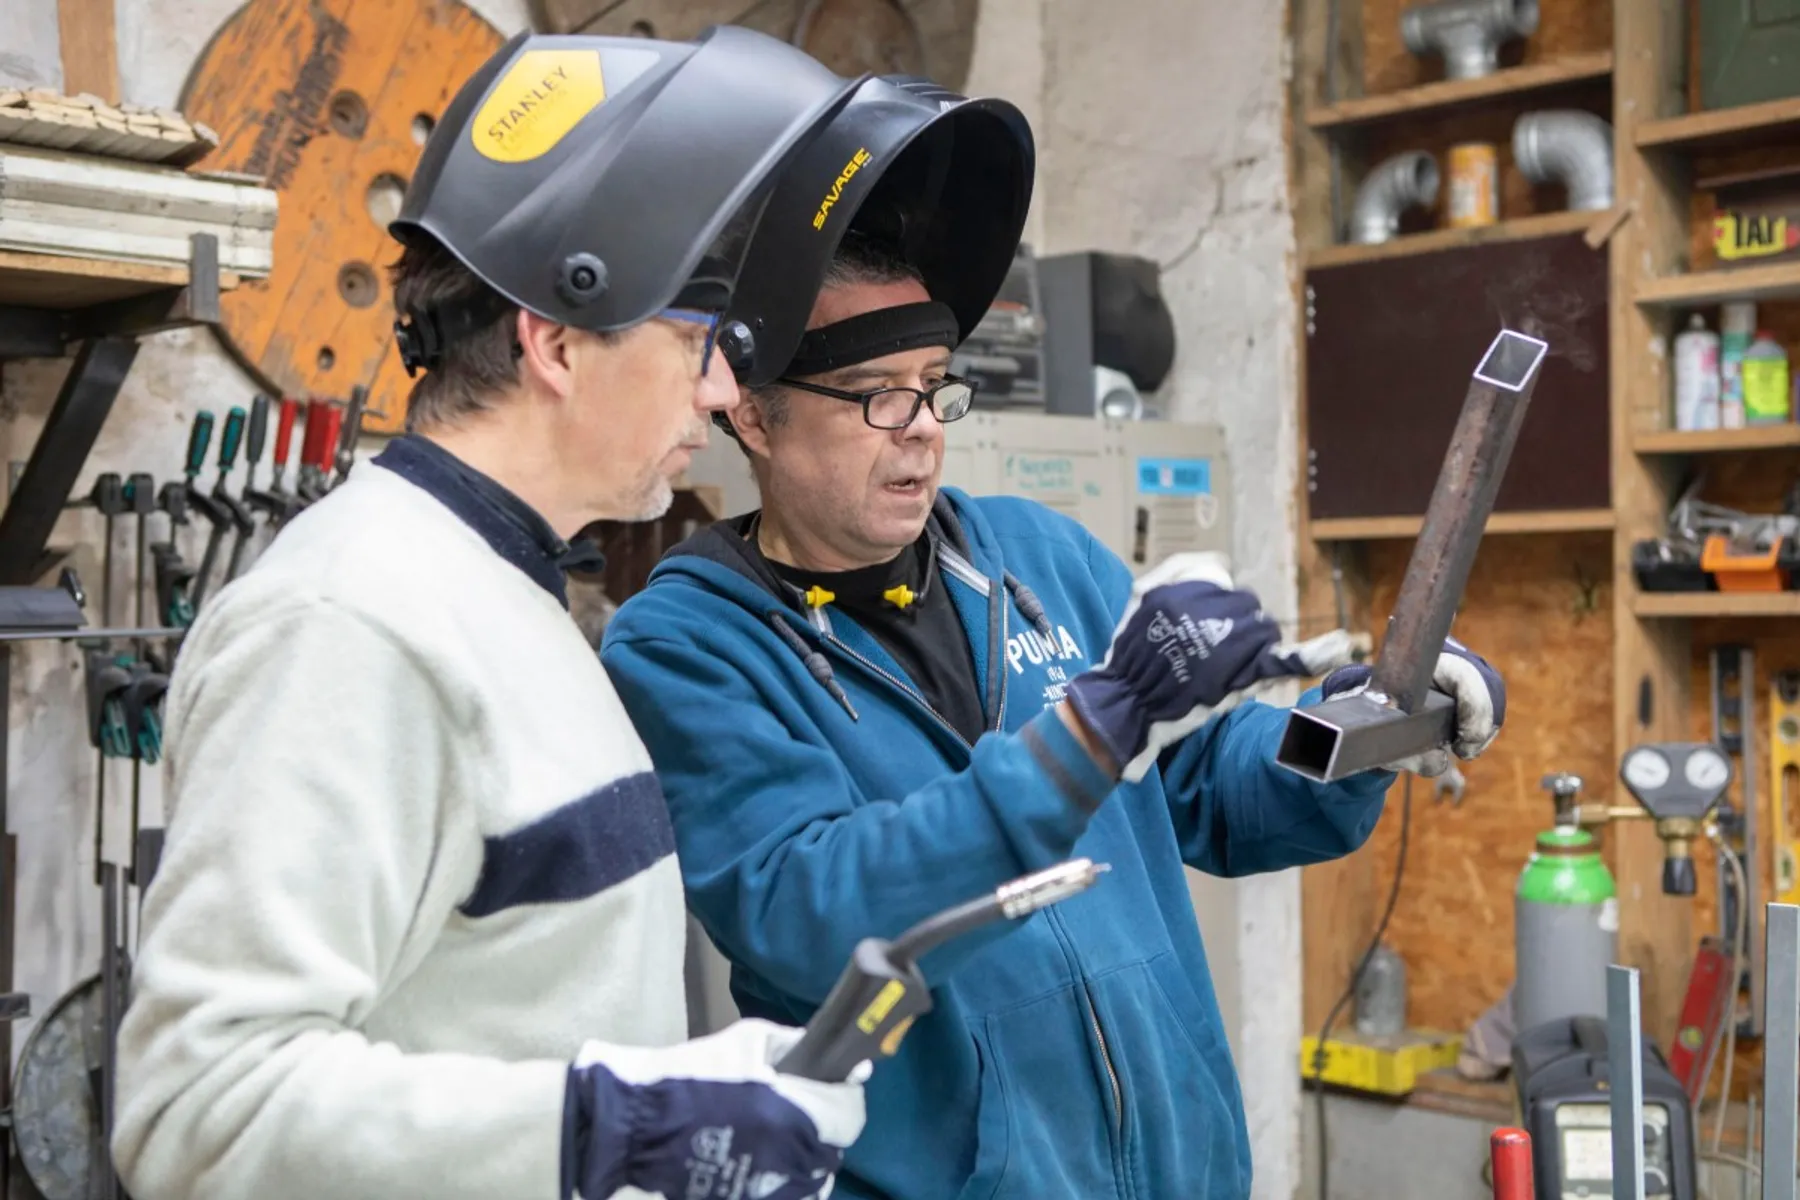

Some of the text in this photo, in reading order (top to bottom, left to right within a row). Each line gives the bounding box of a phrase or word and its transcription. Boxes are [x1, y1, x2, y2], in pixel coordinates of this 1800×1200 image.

[488, 65, 567, 142] STANLEY
[812, 147, 870, 231] SAVAGE
[1007, 624, 1084, 675] PUMA
